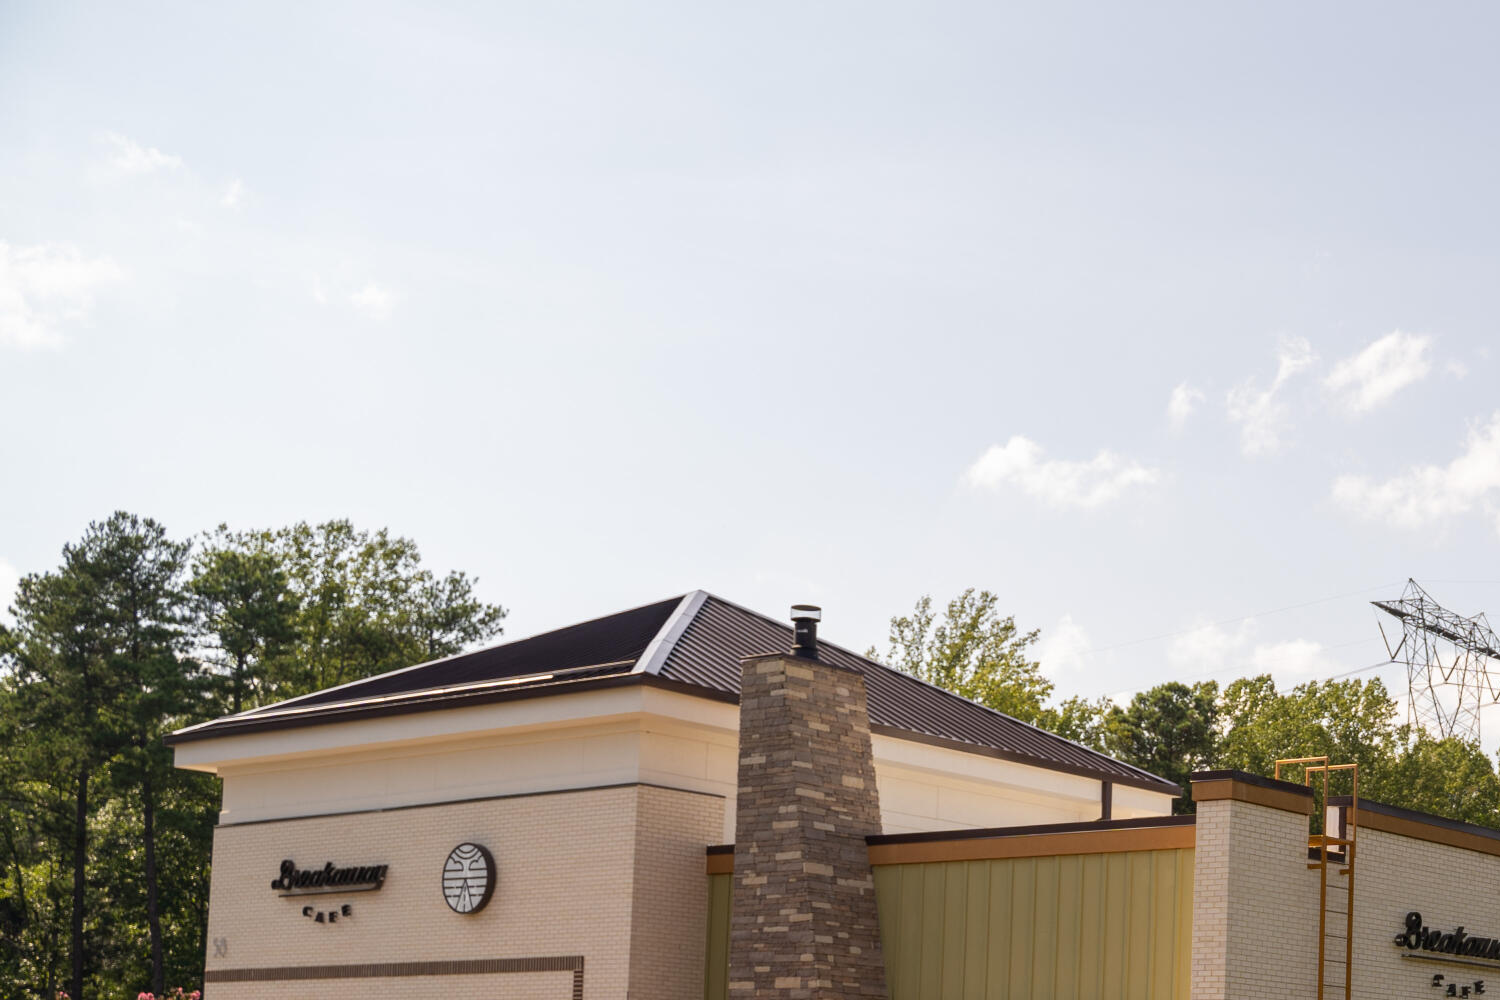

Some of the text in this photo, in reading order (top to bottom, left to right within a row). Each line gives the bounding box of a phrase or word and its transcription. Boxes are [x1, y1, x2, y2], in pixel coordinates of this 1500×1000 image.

[271, 860, 389, 898] Breakaway
[302, 904, 352, 924] CAFE
[1431, 974, 1486, 1000] CAFE
